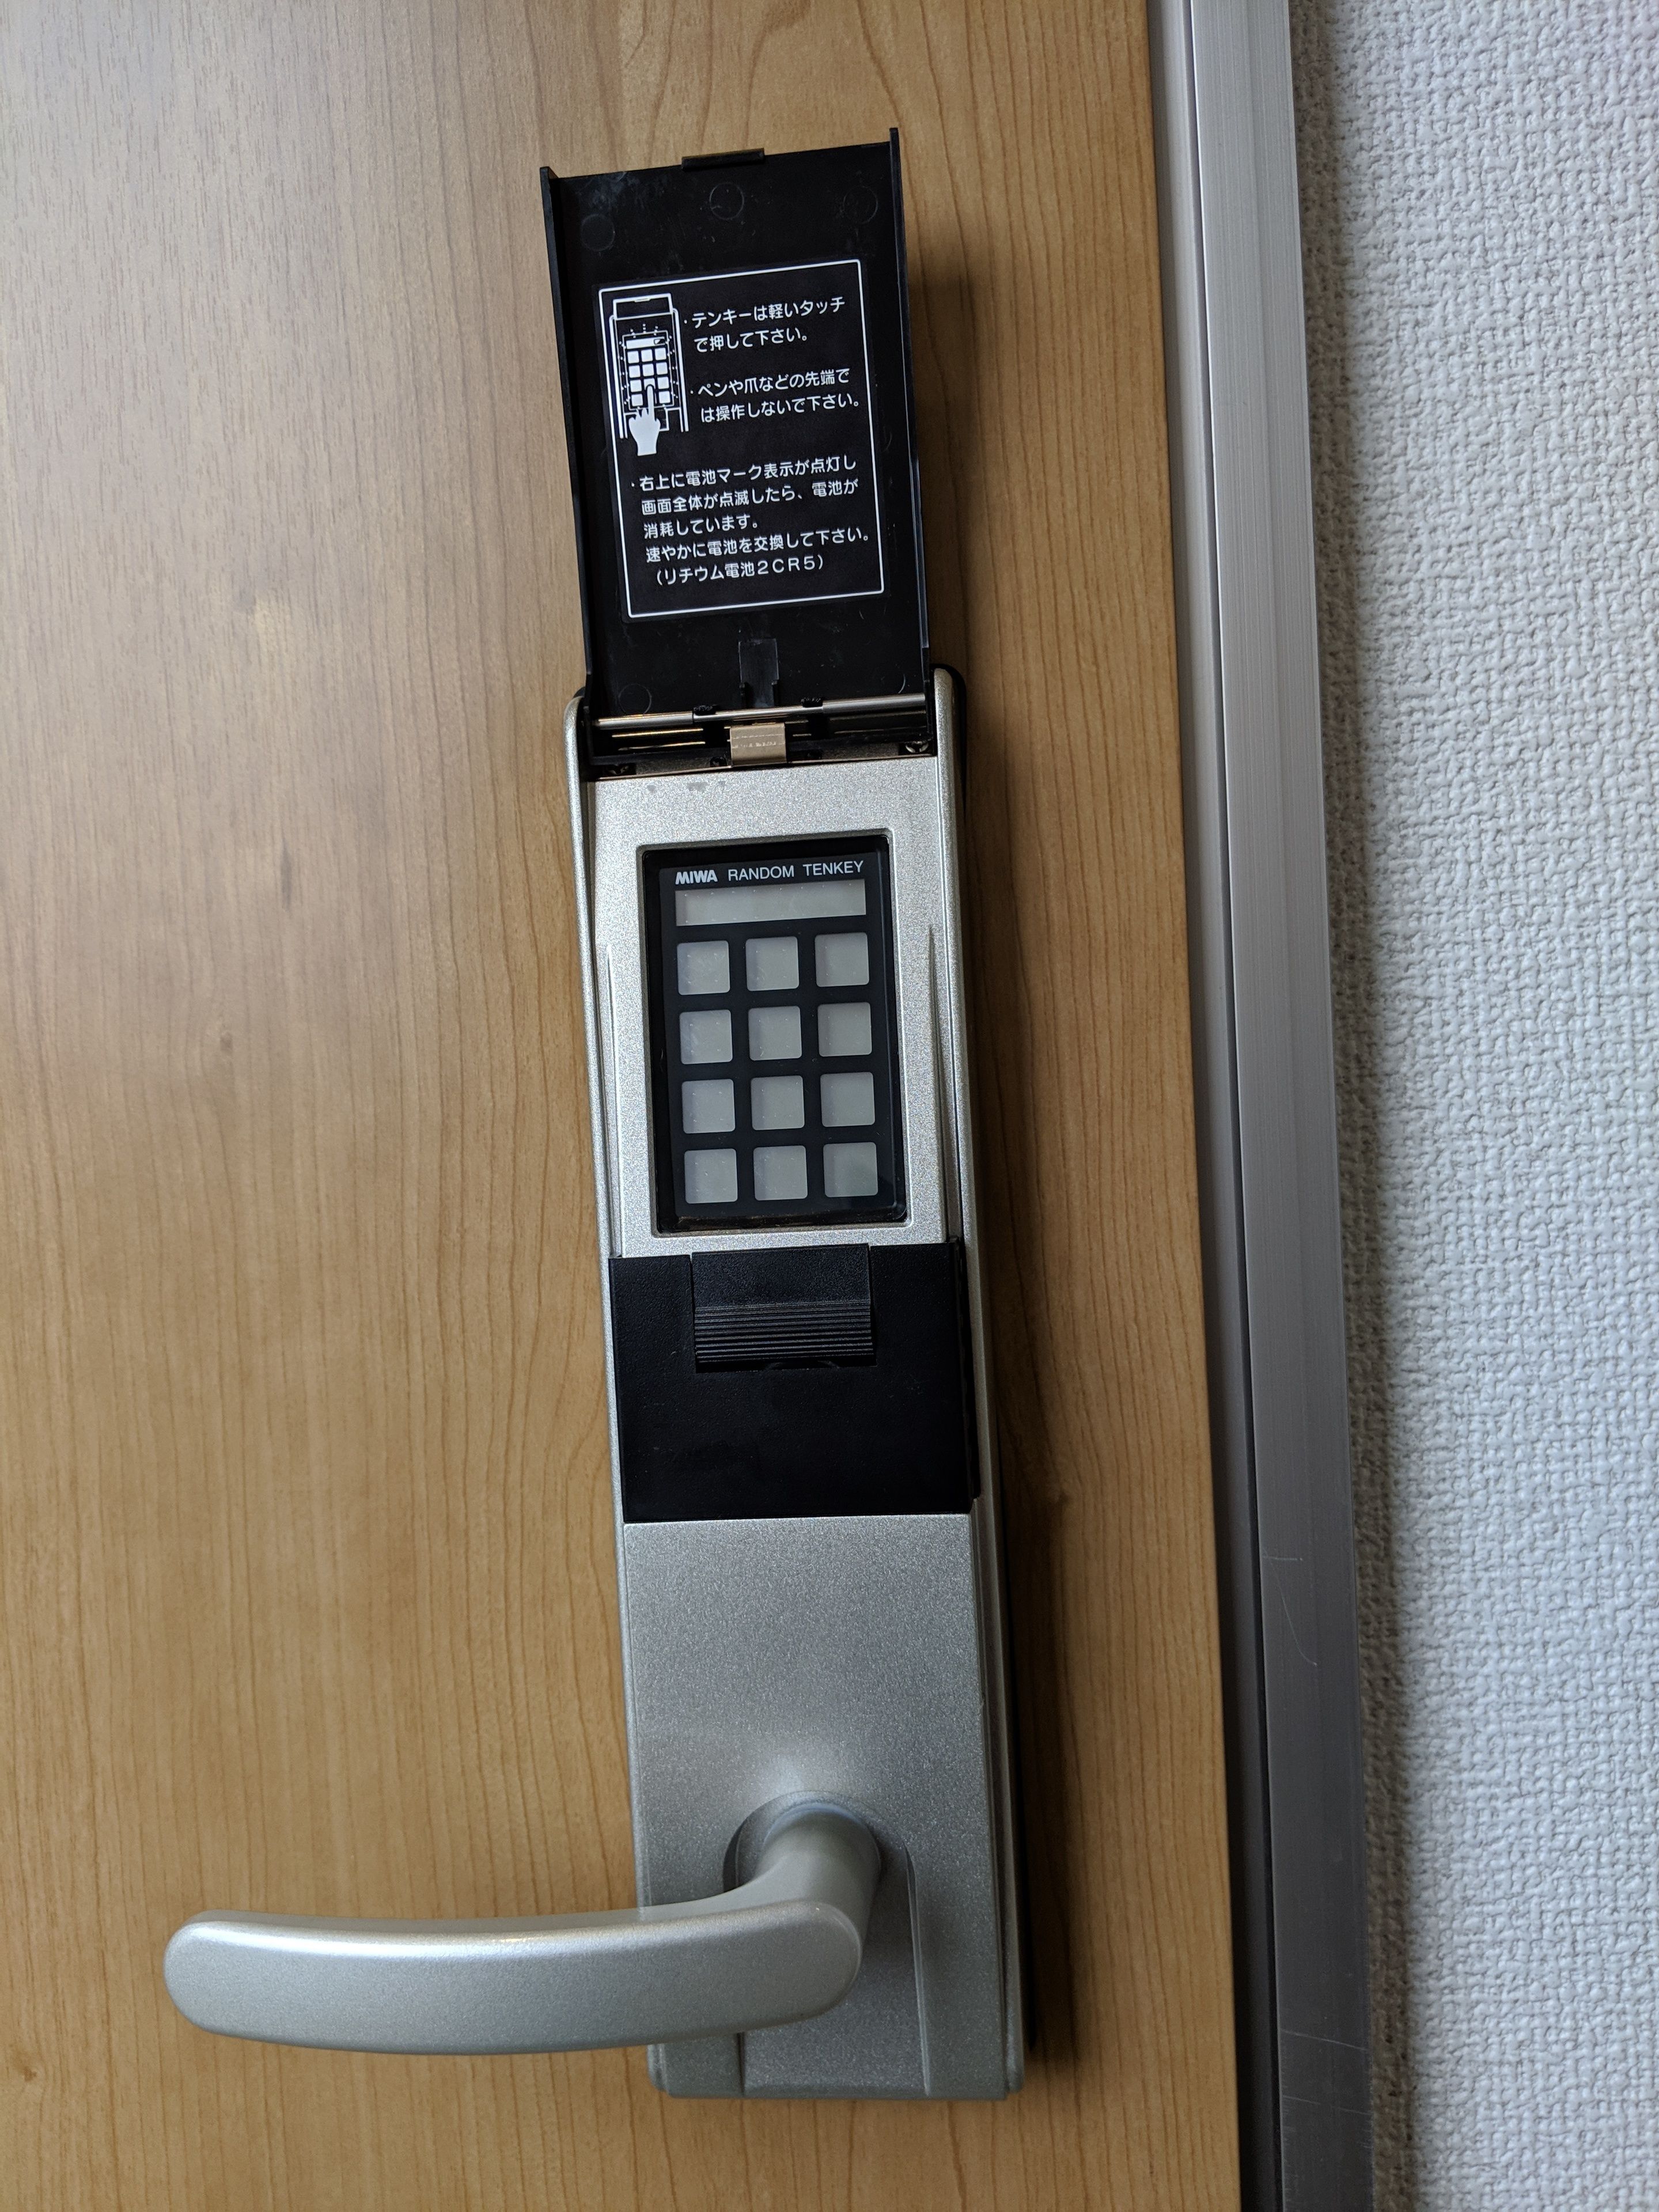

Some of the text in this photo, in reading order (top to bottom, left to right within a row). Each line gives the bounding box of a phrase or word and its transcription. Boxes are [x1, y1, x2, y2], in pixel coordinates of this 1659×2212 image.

[694, 327, 807, 353] で押して下さい。
[701, 393, 859, 423] は操作しないで下さい。
[643, 514, 757, 539] 消耗しています。
[646, 528, 868, 563] 速やかに電池を交換して下さい。
[675, 860, 863, 885] MIWA RANDOM TENKEY
